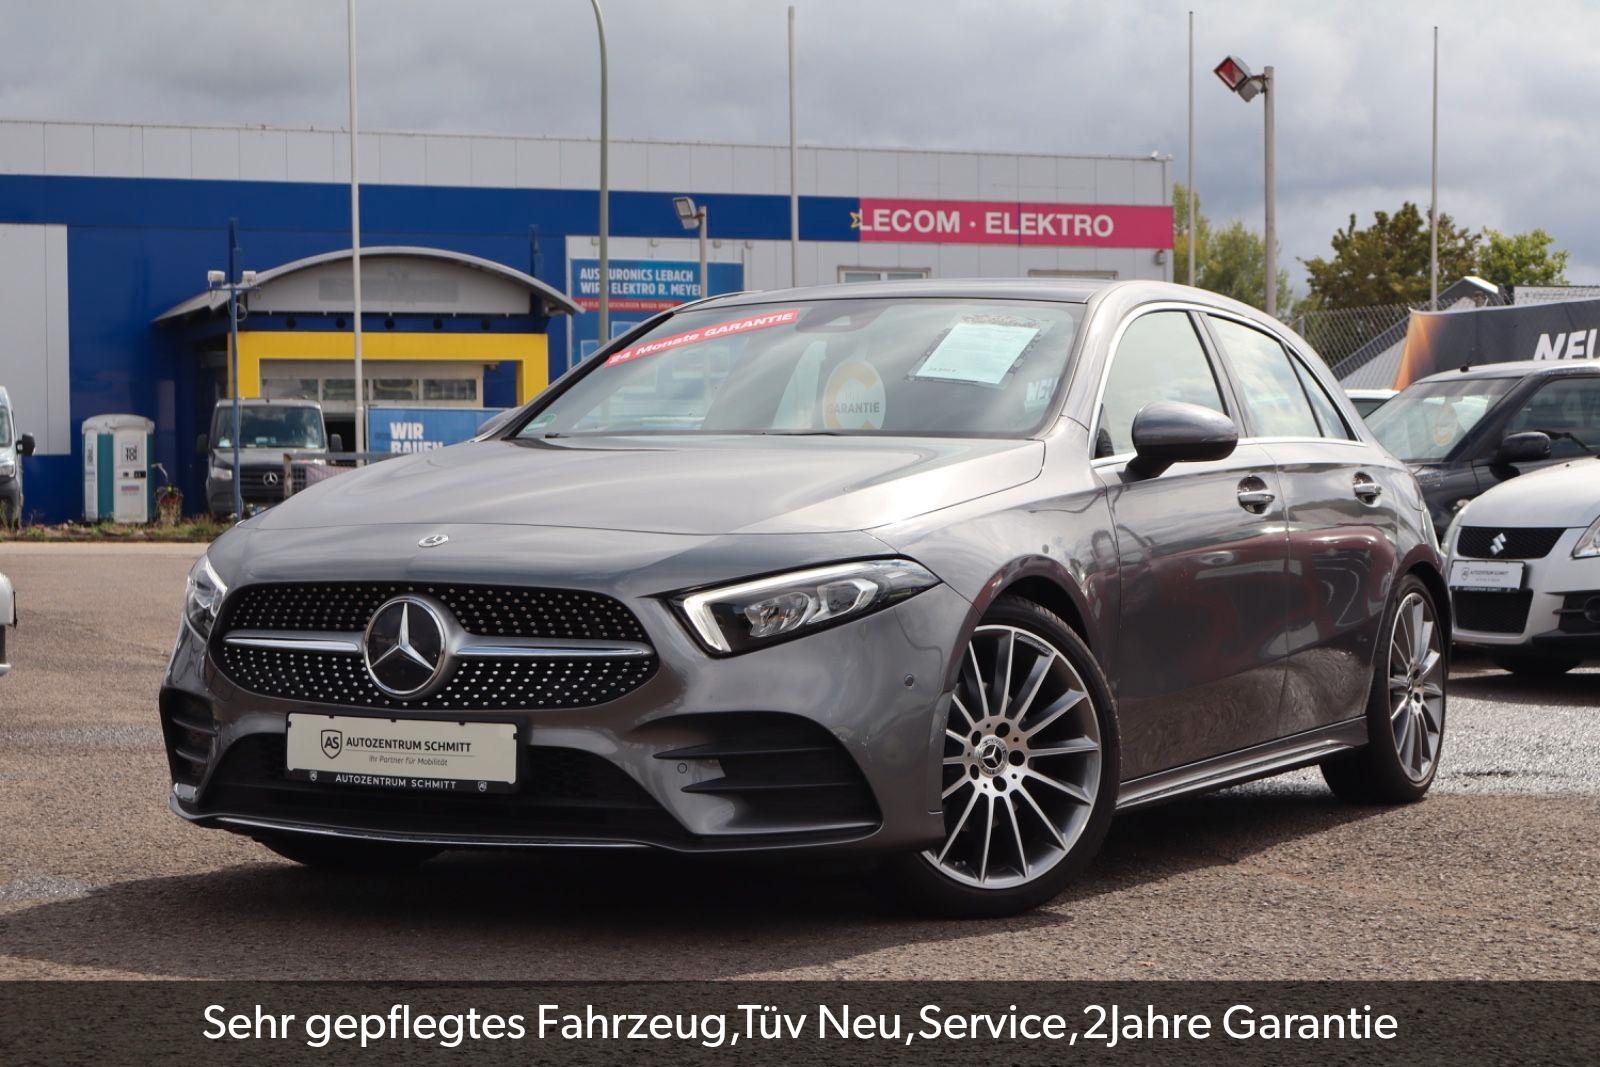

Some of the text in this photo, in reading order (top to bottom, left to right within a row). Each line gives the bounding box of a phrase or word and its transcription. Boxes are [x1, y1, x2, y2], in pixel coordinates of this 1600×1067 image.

[859, 208, 1114, 237] LECOM ELEKTRO
[580, 268, 693, 281] AUS URONICS LEBACH
[580, 282, 609, 294] WIR
[611, 283, 656, 295] ELEKTRO
[658, 285, 669, 296] R.
[609, 313, 793, 364] 24 Monate GARANTIE
[390, 422, 424, 440] WIR
[324, 736, 339, 749] AS
[346, 737, 472, 752] AUTOZENTRUM SCHMITT
[380, 756, 404, 765] Partner
[417, 758, 448, 766] Mobilität
[335, 774, 457, 790] AUTOZENTRUM SCHMITT
